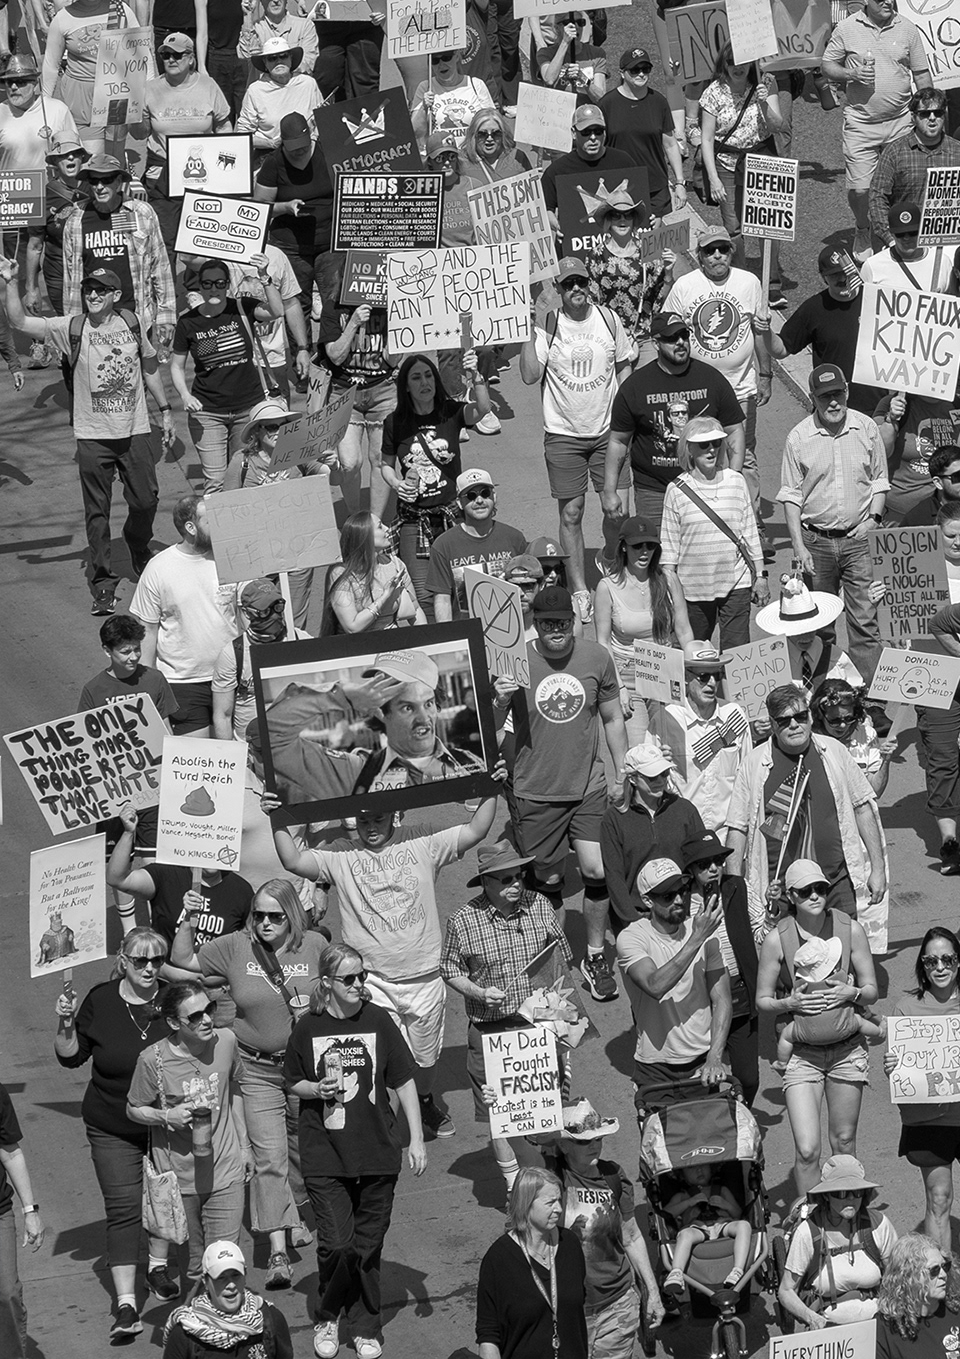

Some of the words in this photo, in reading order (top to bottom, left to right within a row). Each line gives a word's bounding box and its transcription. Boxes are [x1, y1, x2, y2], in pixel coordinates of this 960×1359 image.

[343, 178, 398, 194] HANDS
[403, 178, 439, 194] OFF!
[747, 171, 795, 194] DEFEND
[195, 200, 220, 213] NOT
[239, 206, 259, 220] MY
[745, 206, 793, 229] RIGHTS
[188, 218, 218, 231] FAUX
[229, 225, 259, 239] KING
[195, 237, 242, 253] PRESIDENT
[876, 289, 912, 319] NO
[871, 318, 957, 367] KING
[872, 354, 951, 395] WAY!!
[646, 393, 668, 404] FEAR
[668, 389, 707, 402] FACTORY
[172, 756, 215, 767] Abolish
[218, 758, 236, 770] the
[173, 771, 198, 782] Turd
[203, 772, 233, 784] Reich
[487, 1036, 511, 1054] My
[518, 1029, 548, 1048] Dad
[502, 1053, 551, 1075] Fought
[500, 1071, 561, 1095] FASCISM
